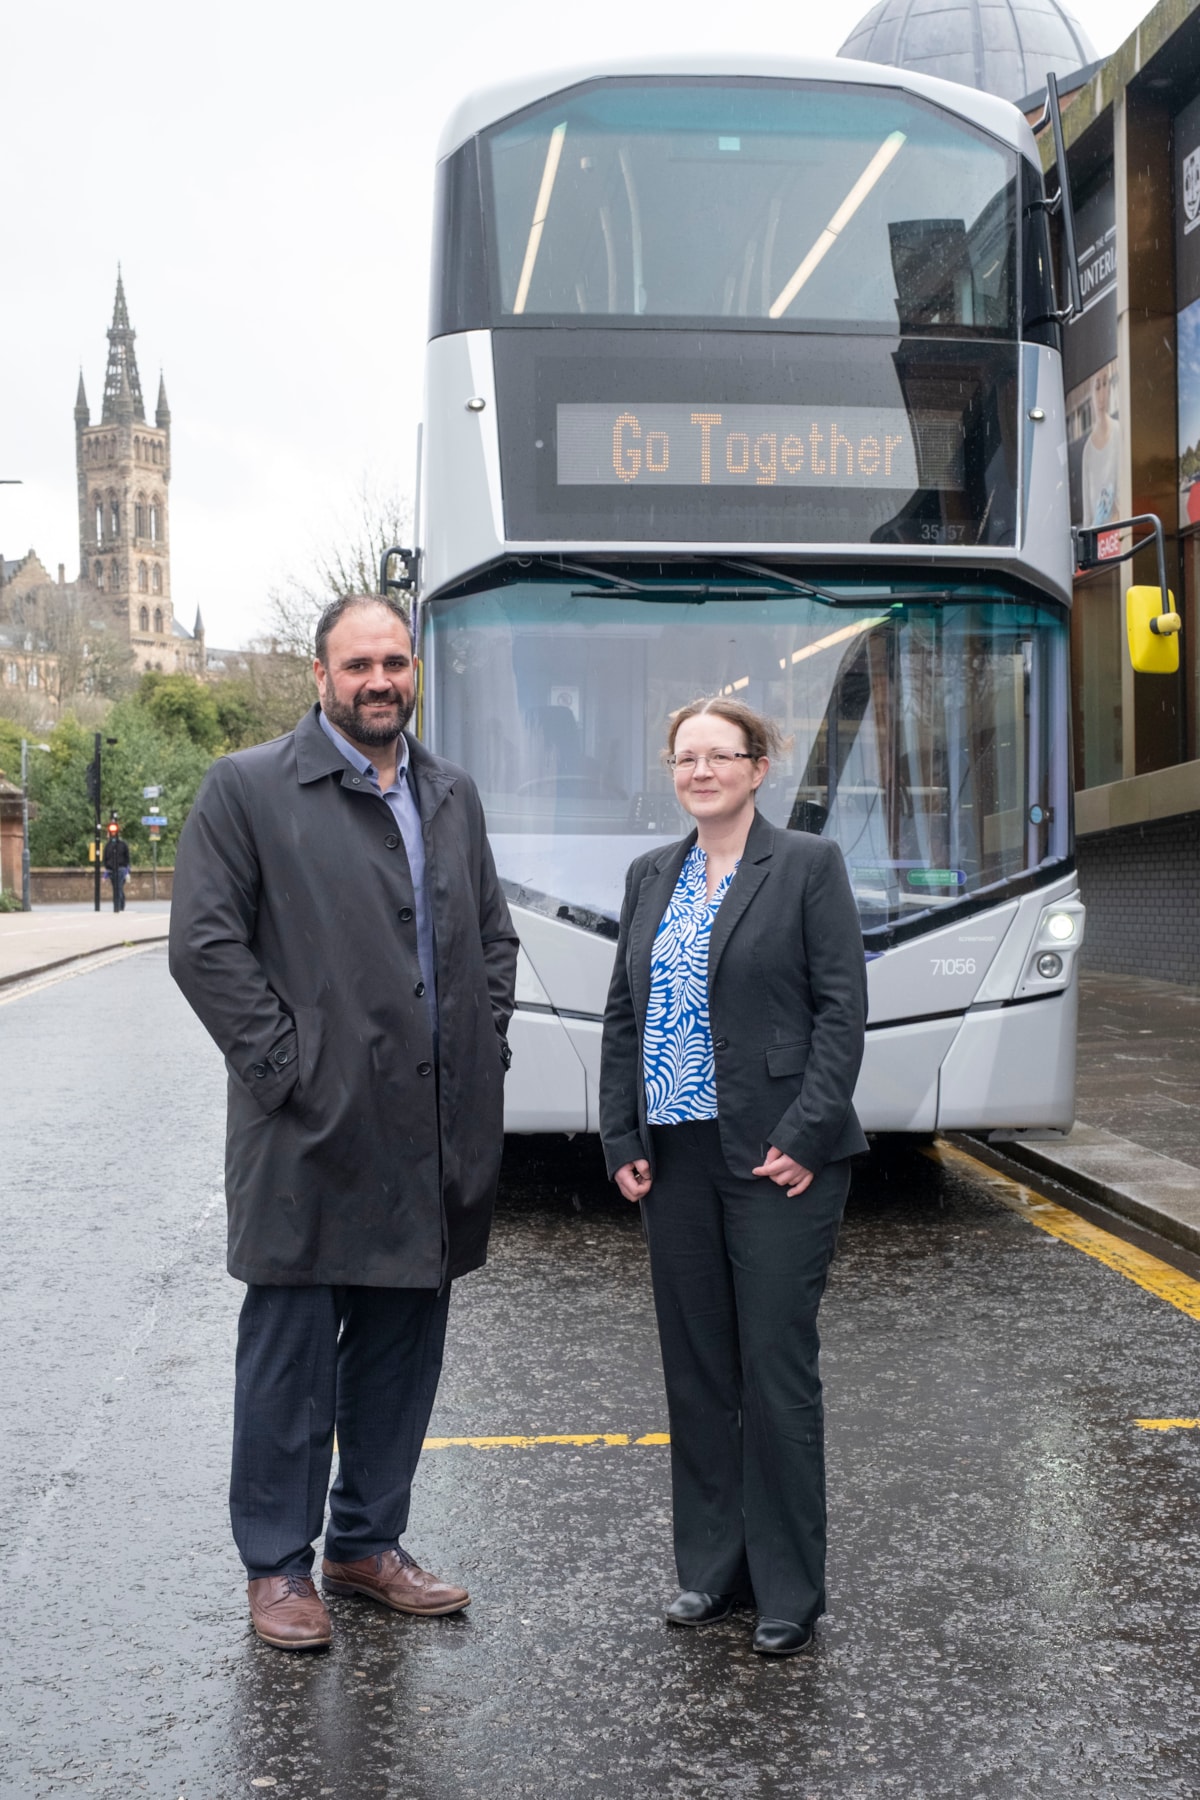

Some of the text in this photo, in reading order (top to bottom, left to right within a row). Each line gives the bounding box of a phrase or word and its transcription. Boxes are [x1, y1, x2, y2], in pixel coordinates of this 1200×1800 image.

[1080, 246, 1117, 297] UNTERI
[612, 412, 903, 484] Go Together
[920, 523, 967, 541] 35157
[929, 957, 977, 976] 71056
